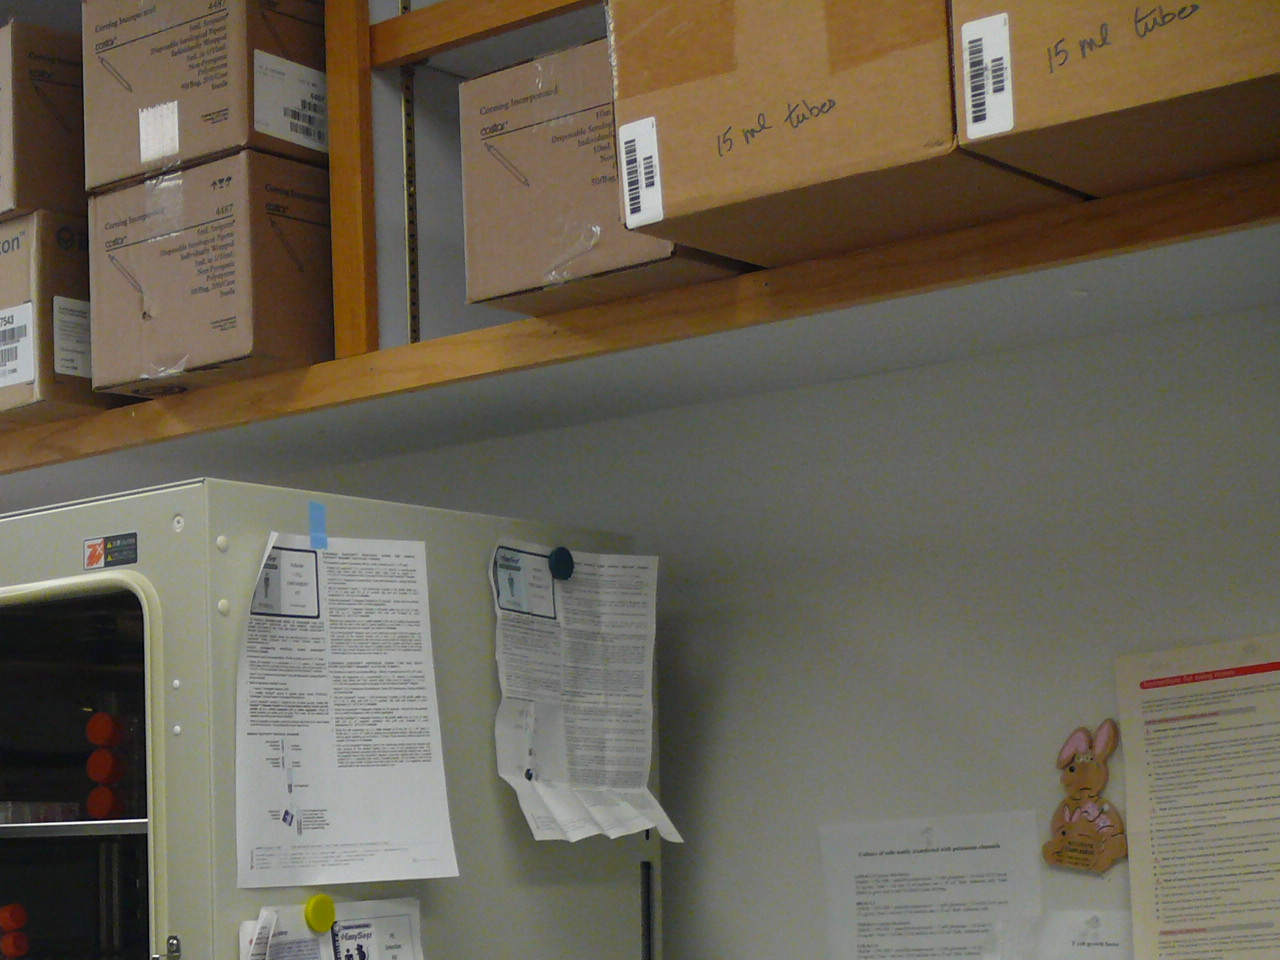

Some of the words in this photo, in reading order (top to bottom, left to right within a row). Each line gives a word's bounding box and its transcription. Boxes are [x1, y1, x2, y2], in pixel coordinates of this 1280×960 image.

[1047, 37, 1068, 73] 15
[1079, 22, 1111, 58] ml
[1134, 4, 1199, 38] tubes
[717, 126, 733, 157] 15
[744, 113, 772, 144] ml
[784, 99, 836, 129] tubes
